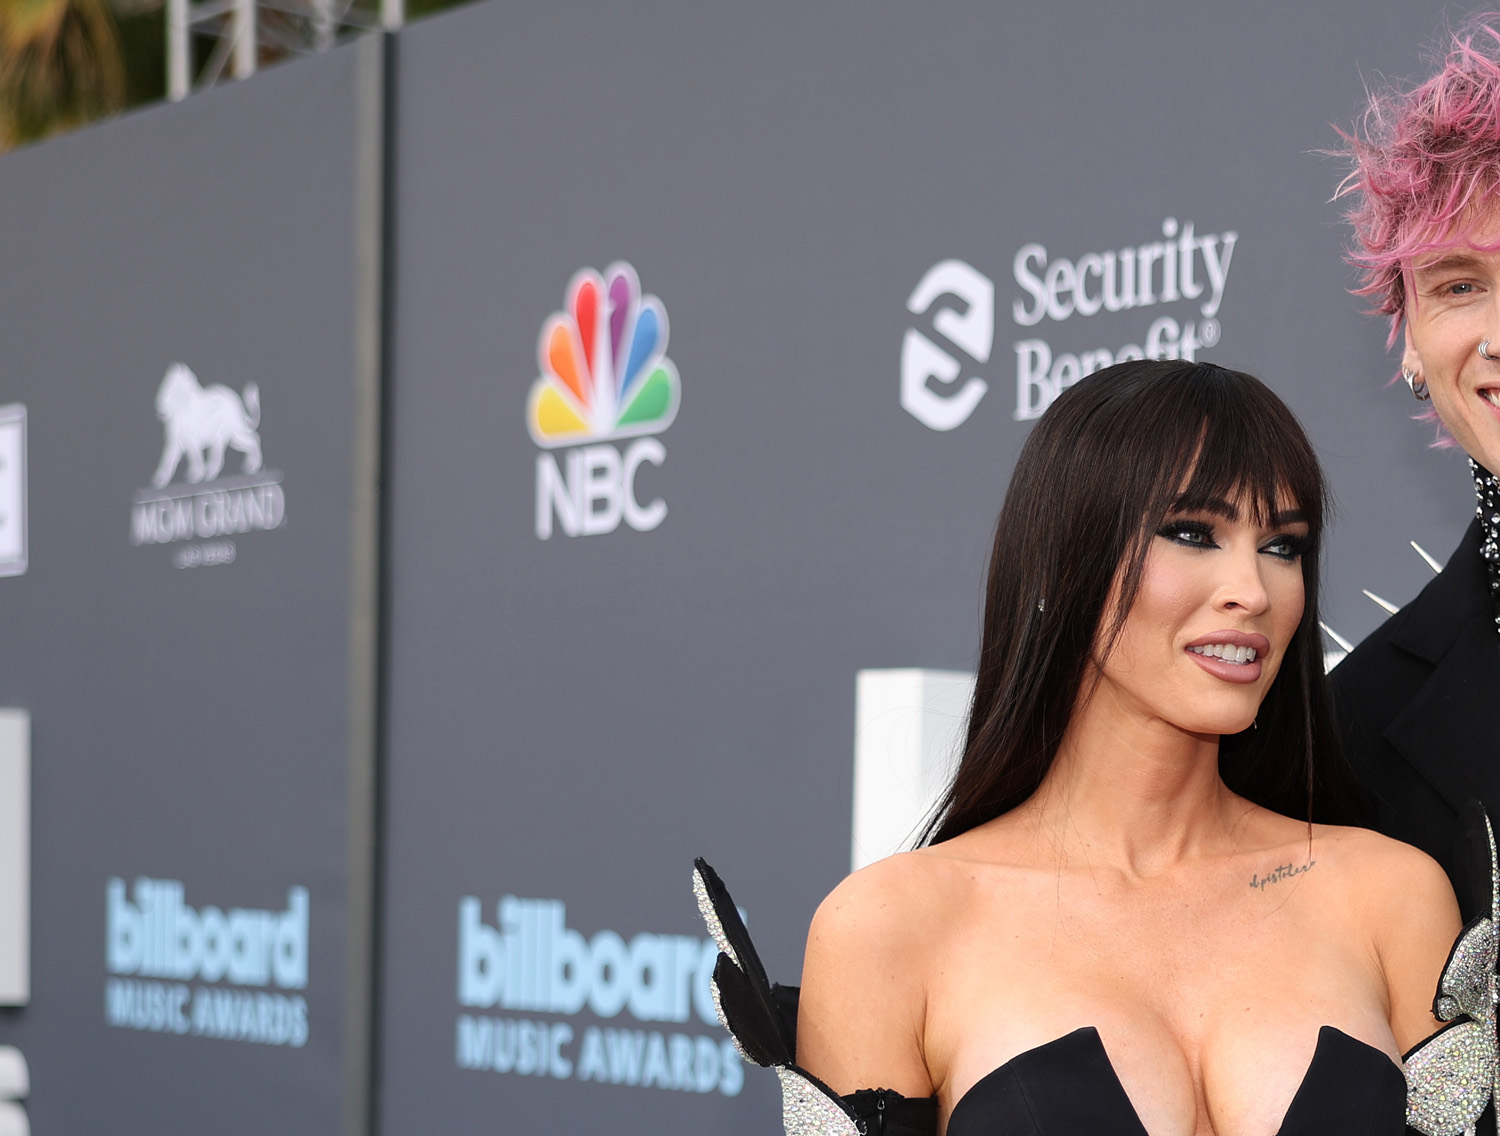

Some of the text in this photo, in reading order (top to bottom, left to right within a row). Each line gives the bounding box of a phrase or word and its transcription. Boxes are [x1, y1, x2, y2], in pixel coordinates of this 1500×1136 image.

[1012, 216, 1239, 326] Security
[535, 438, 668, 541] NBC
[105, 874, 310, 990] billboard
[105, 976, 309, 1048] MUSIC AWARDS
[456, 1013, 745, 1097] MUSIC AWARDS
